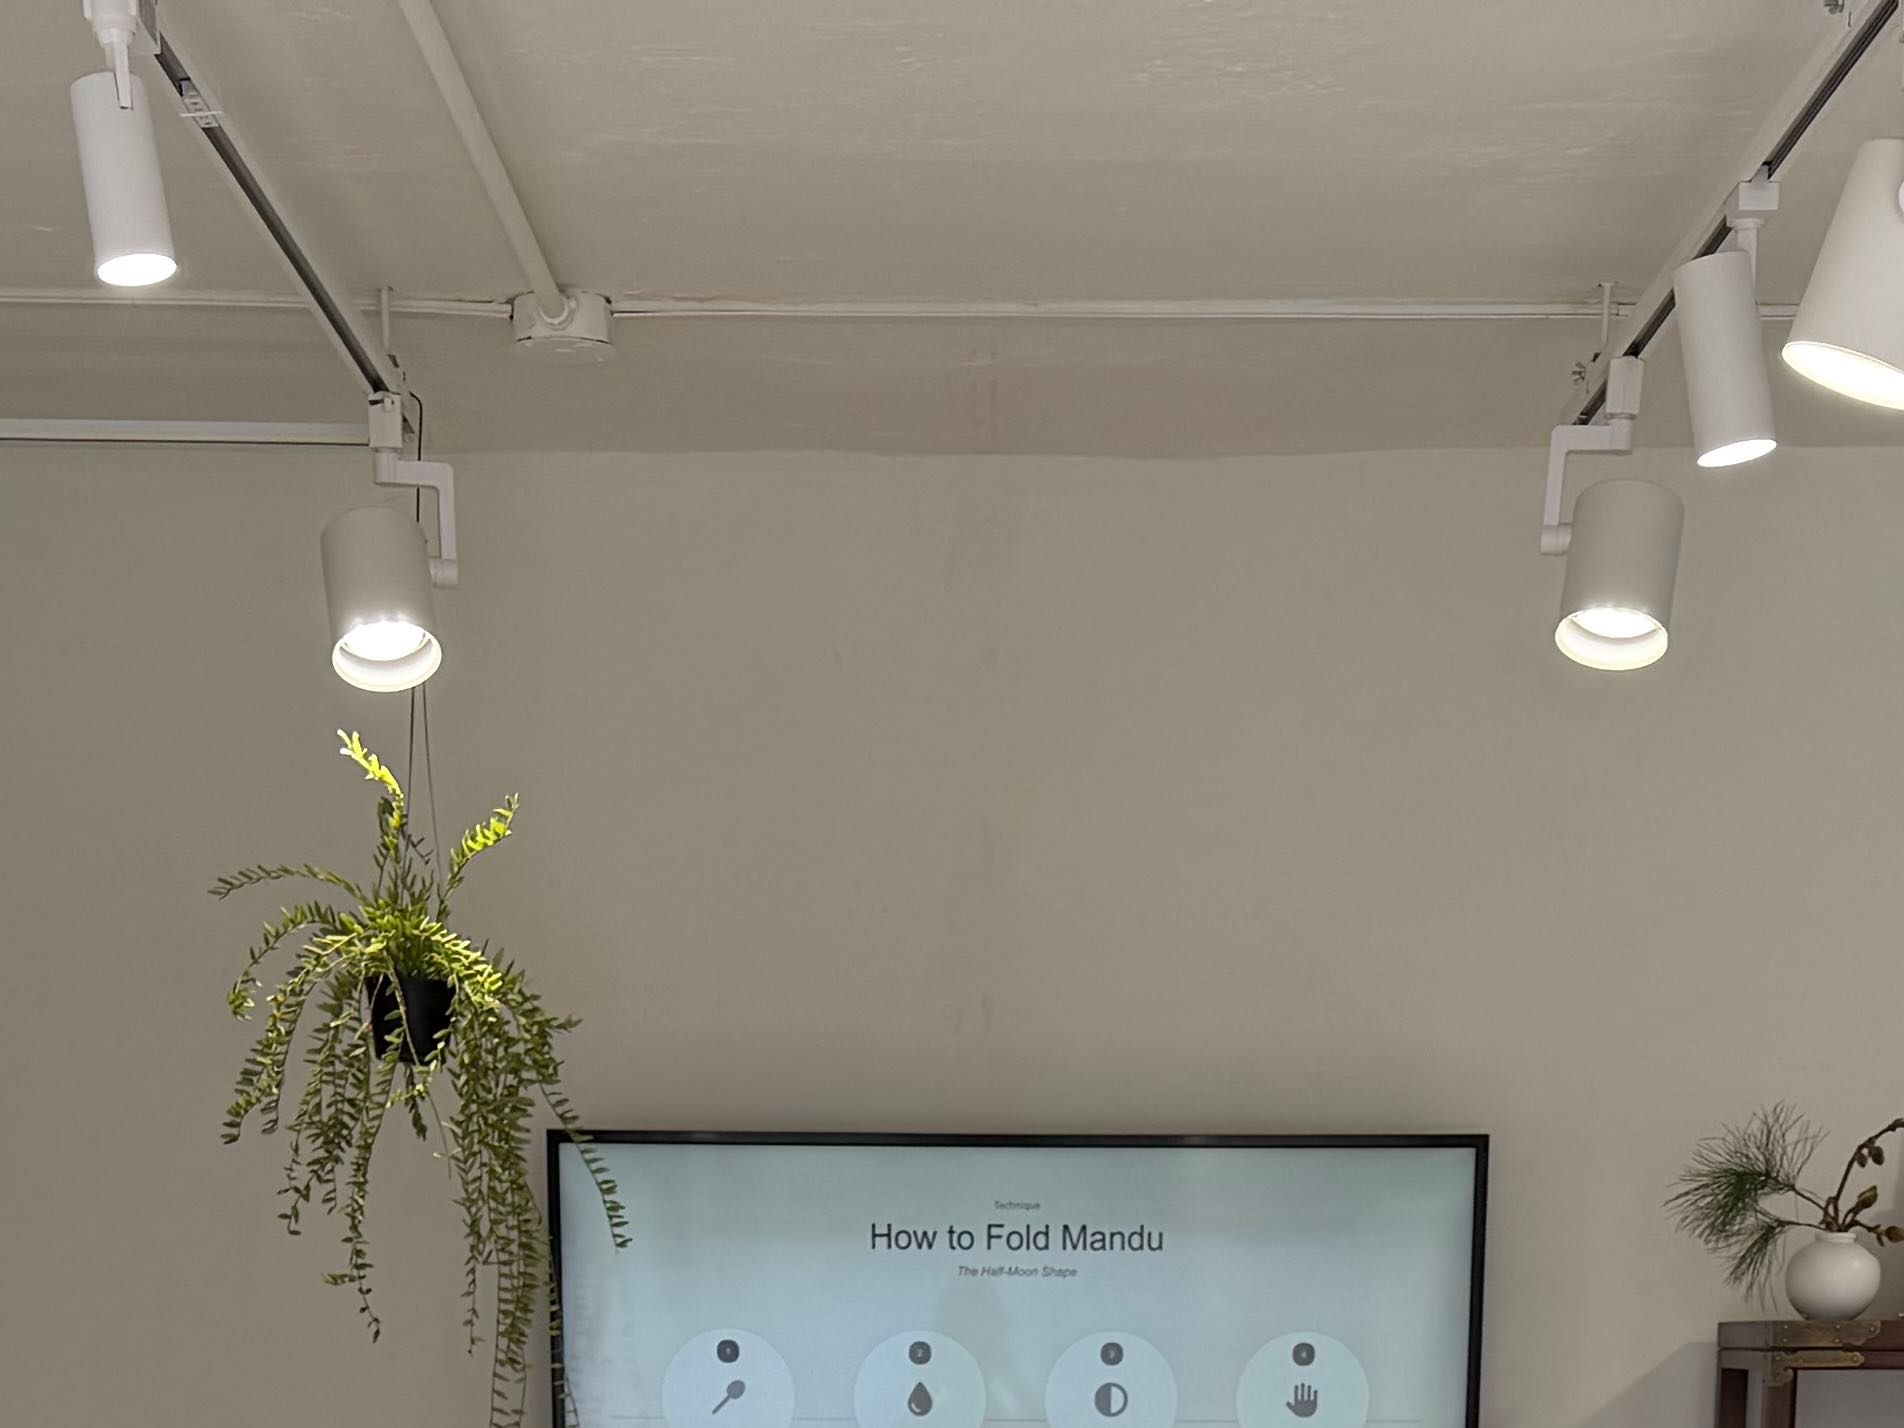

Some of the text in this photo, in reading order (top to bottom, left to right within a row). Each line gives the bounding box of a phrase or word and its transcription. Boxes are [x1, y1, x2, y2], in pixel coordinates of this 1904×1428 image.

[870, 1223, 1164, 1251] How to Fold Mandu
[957, 1265, 1078, 1279] The Half-Moon Shape
